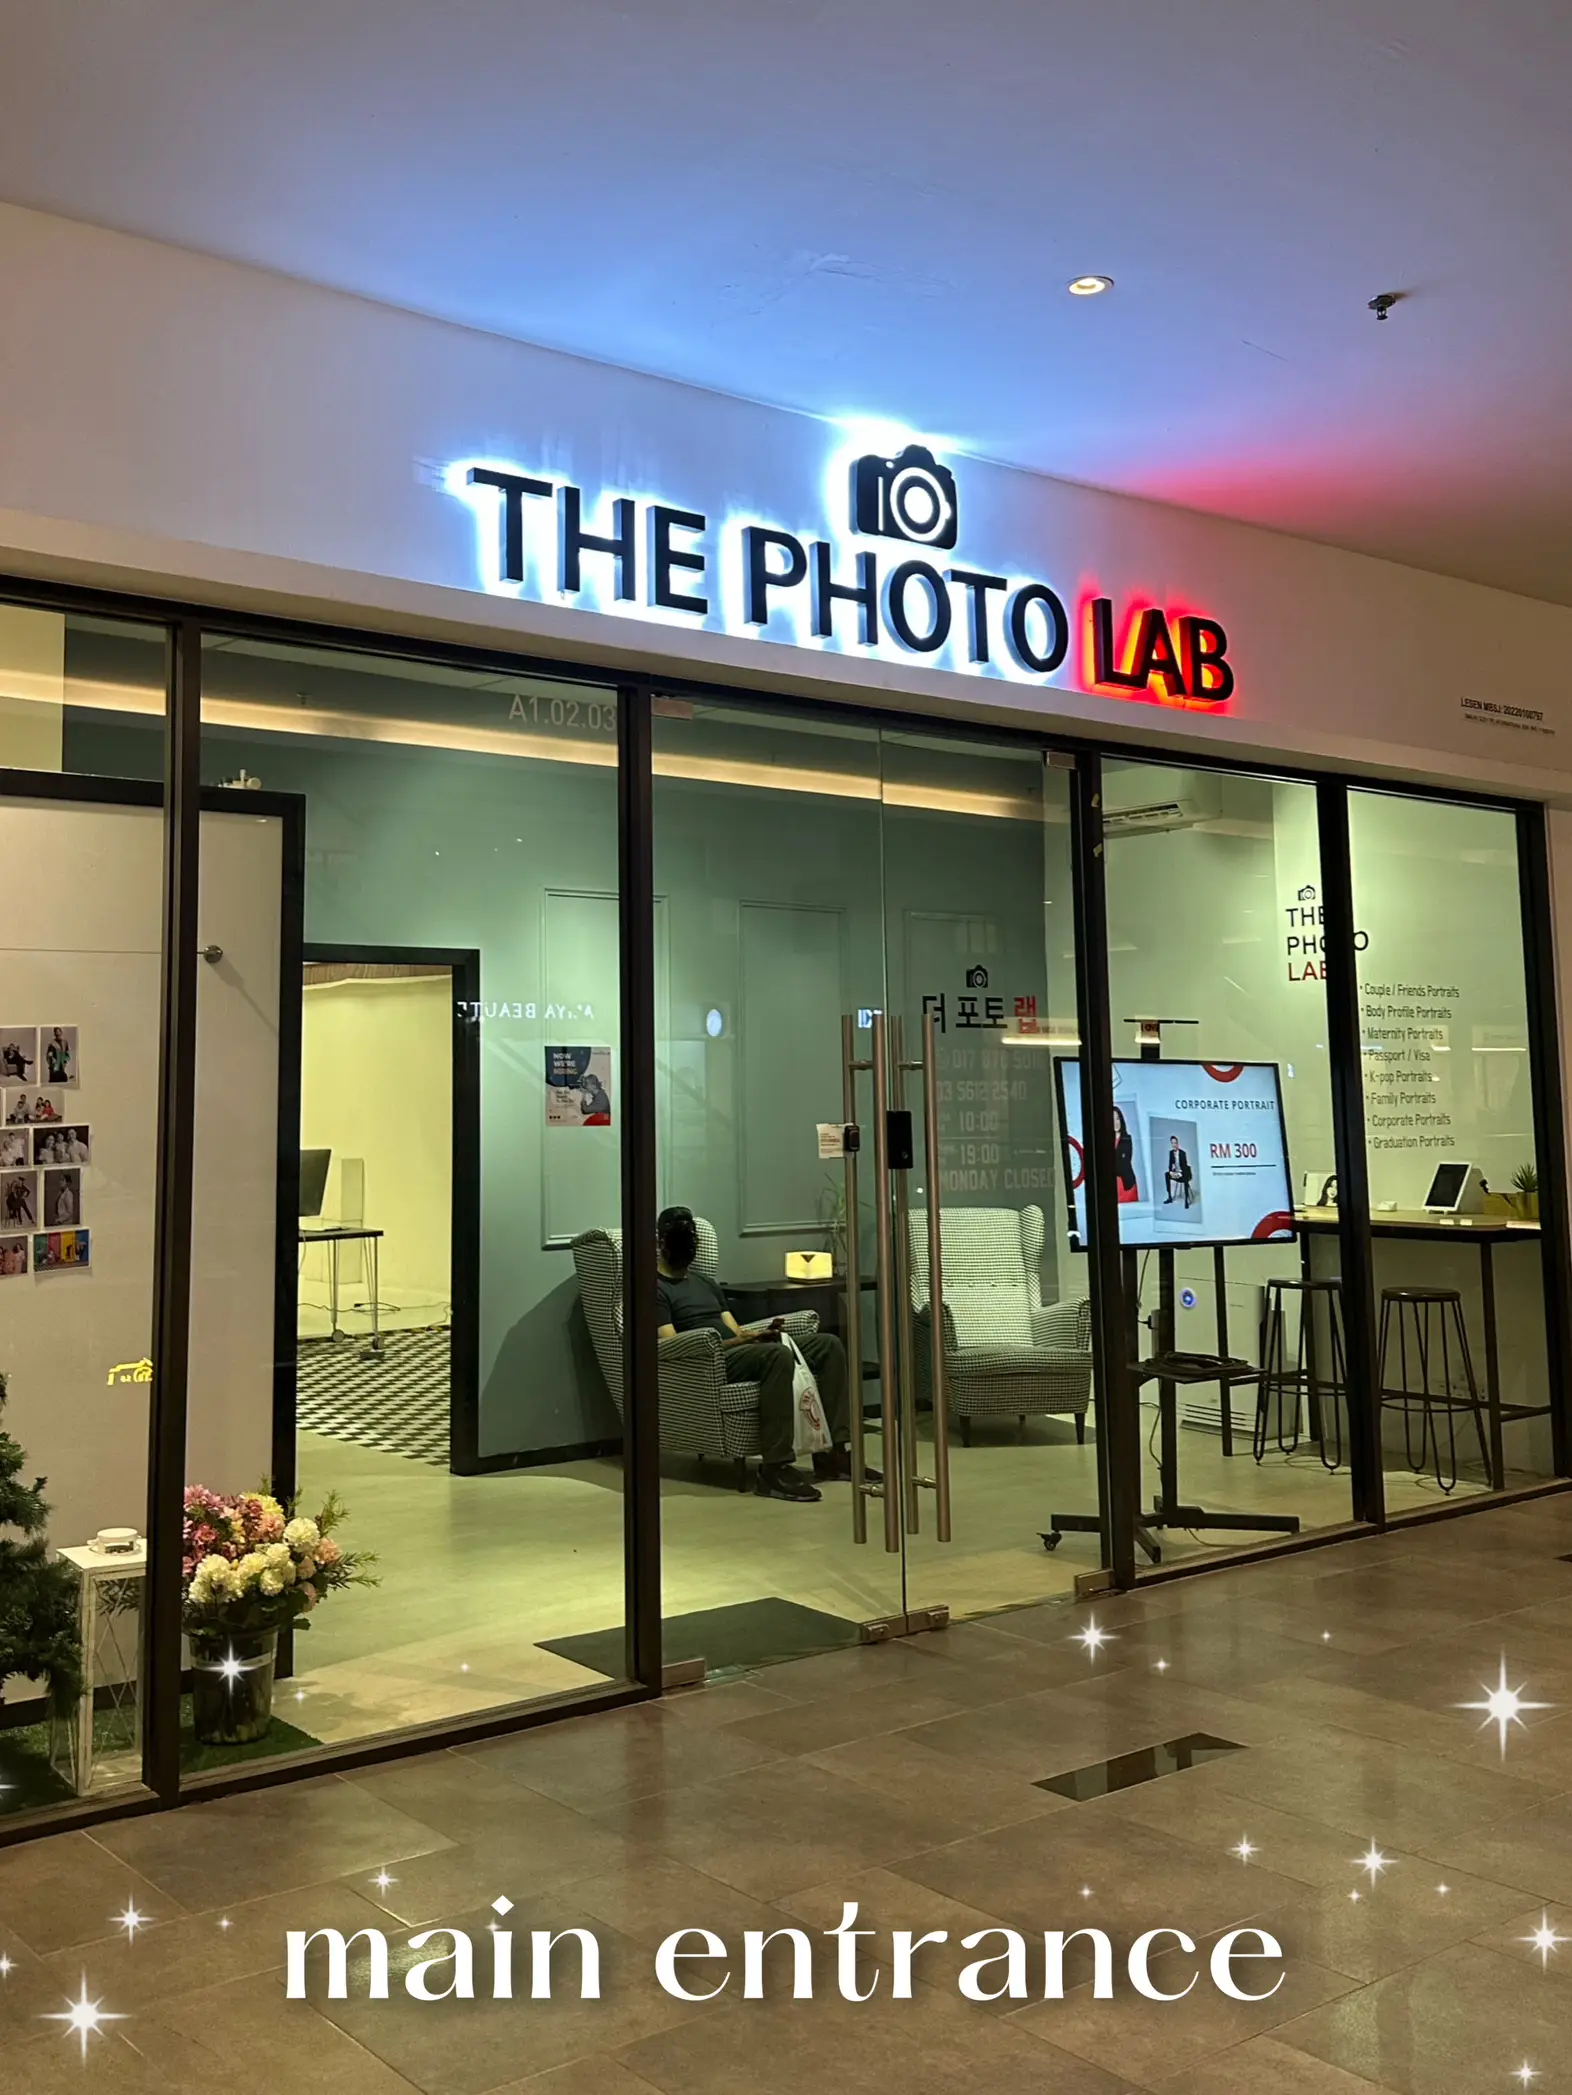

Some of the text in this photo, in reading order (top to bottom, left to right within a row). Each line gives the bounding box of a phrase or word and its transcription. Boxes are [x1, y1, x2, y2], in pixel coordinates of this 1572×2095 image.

[467, 468, 1235, 703] THE PHOTO LAB
[1287, 931, 1369, 955] PHO
[1365, 983, 1391, 998] Couple
[1397, 984, 1426, 997] Friends
[1427, 985, 1460, 998] Portraits
[956, 996, 1008, 1028] 포토
[1013, 995, 1037, 1034] 랩
[1366, 1004, 1452, 1020] Body Profile Portraits
[1367, 1027, 1443, 1042] Maternity Portraits
[1368, 1049, 1405, 1064] Passport
[1413, 1049, 1431, 1061] Visa
[1369, 1070, 1432, 1086] K-pop Portraits
[1175, 1100, 1275, 1110] CORPORATE PORTRAIT
[1371, 1092, 1436, 1107] Family Portraits
[959, 1111, 999, 1132] 10:00
[1372, 1113, 1451, 1129] Corporate Portraits
[1373, 1135, 1455, 1149] Graduation Portraits
[960, 1143, 1000, 1165] 19:00
[1209, 1143, 1257, 1158] RM 300
